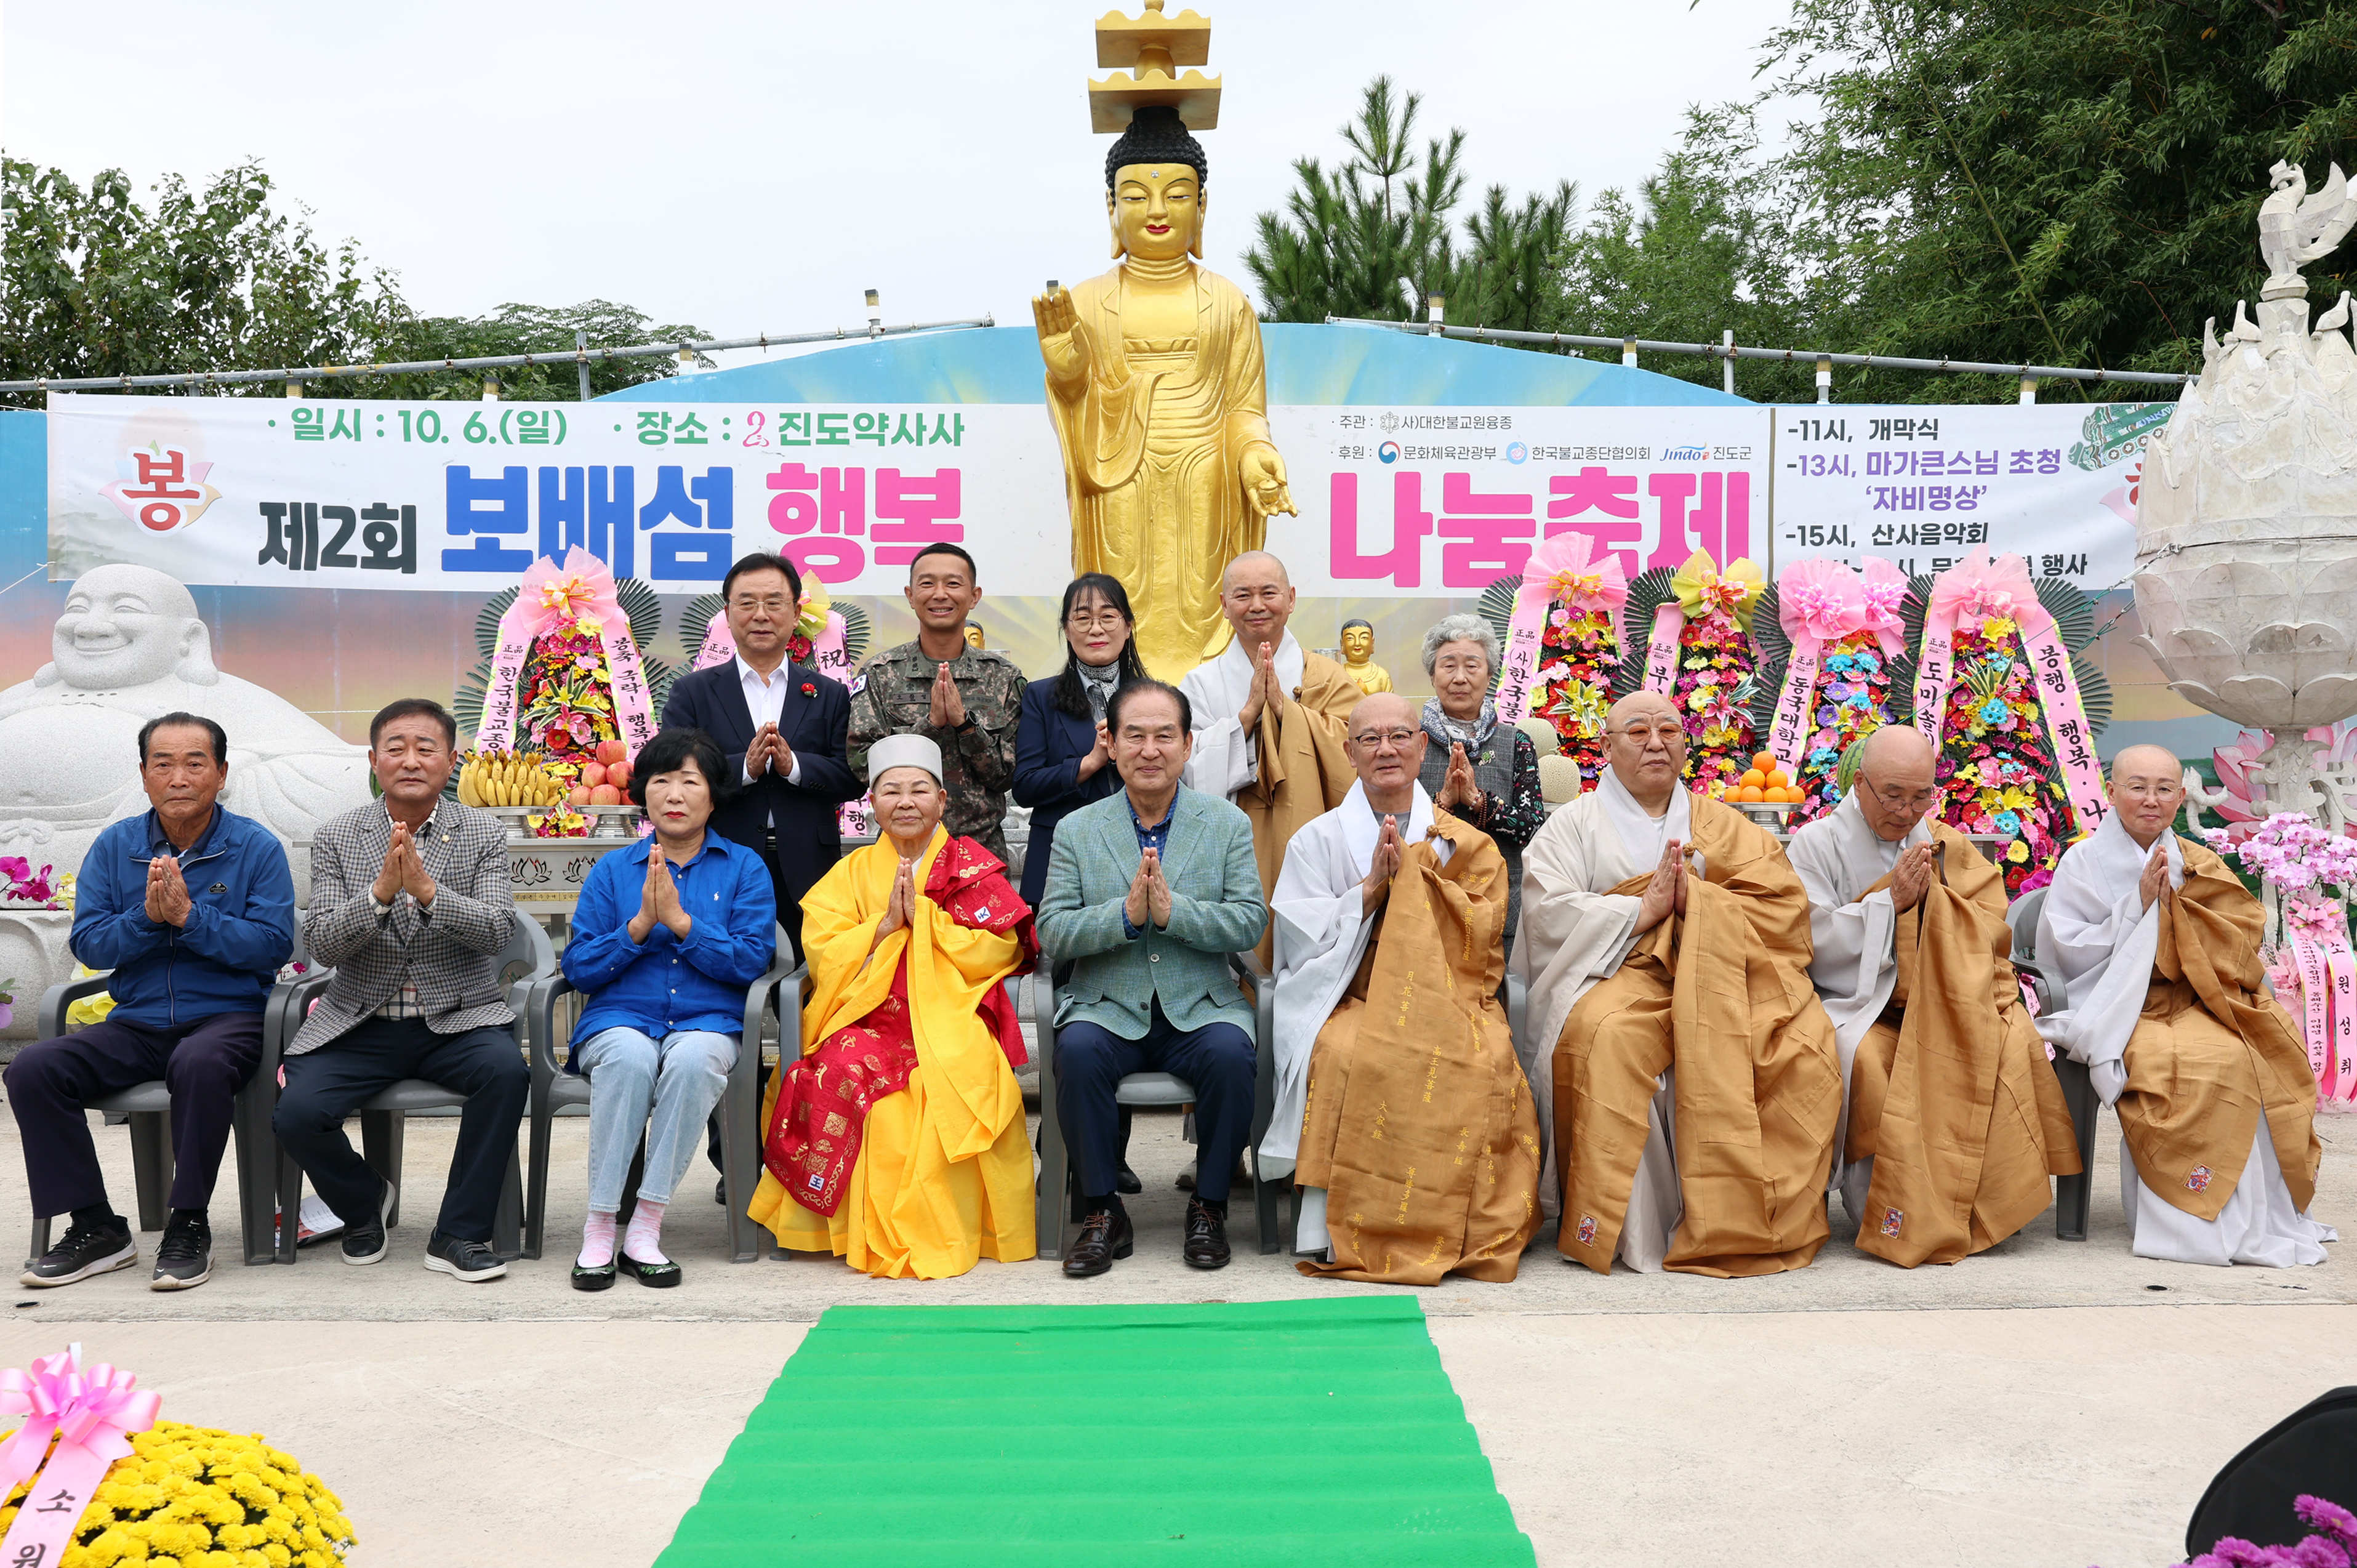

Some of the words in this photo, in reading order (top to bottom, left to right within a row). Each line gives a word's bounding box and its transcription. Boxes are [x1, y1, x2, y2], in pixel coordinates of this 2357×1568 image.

[292, 408, 362, 441] 일시
[398, 410, 449, 444] 10.
[463, 409, 567, 445] 6.(일)
[636, 412, 709, 445] 장소
[779, 412, 965, 446] 진도약사사
[1339, 416, 1366, 429] 주관
[1401, 416, 1512, 430] 사)대한불교원융종
[1869, 419, 1938, 441] 개막식
[1338, 446, 1364, 459] 후원
[1404, 446, 1496, 460] 문화체육관광부
[1532, 446, 1650, 460] 한국불교종단협의회
[1660, 448, 1701, 462] Jindo
[1713, 446, 1751, 460] 진도군
[1866, 449, 1999, 476] 마가큰스님
[2009, 449, 2061, 475] 초청
[123, 450, 199, 531] 봉
[258, 501, 417, 574] 제2회
[441, 465, 733, 581] 보배섬
[766, 463, 964, 584] 행복
[1330, 467, 1750, 588] 나눔축제
[1872, 522, 1988, 546] 산사음악회
[2041, 553, 2088, 579] 행사
[1514, 629, 1535, 640] 正品
[1929, 638, 1947, 649] 正品
[502, 644, 523, 654] 正品
[707, 643, 729, 656] 正品
[820, 648, 847, 670] 祝
[1654, 643, 1672, 654] 正品
[1796, 656, 1815, 666] 正品
[2038, 645, 2066, 693] 봉행
[481, 666, 518, 759] 한국불교종
[1775, 675, 1809, 765] 동국대학교
[2058, 719, 2090, 771] 행복
